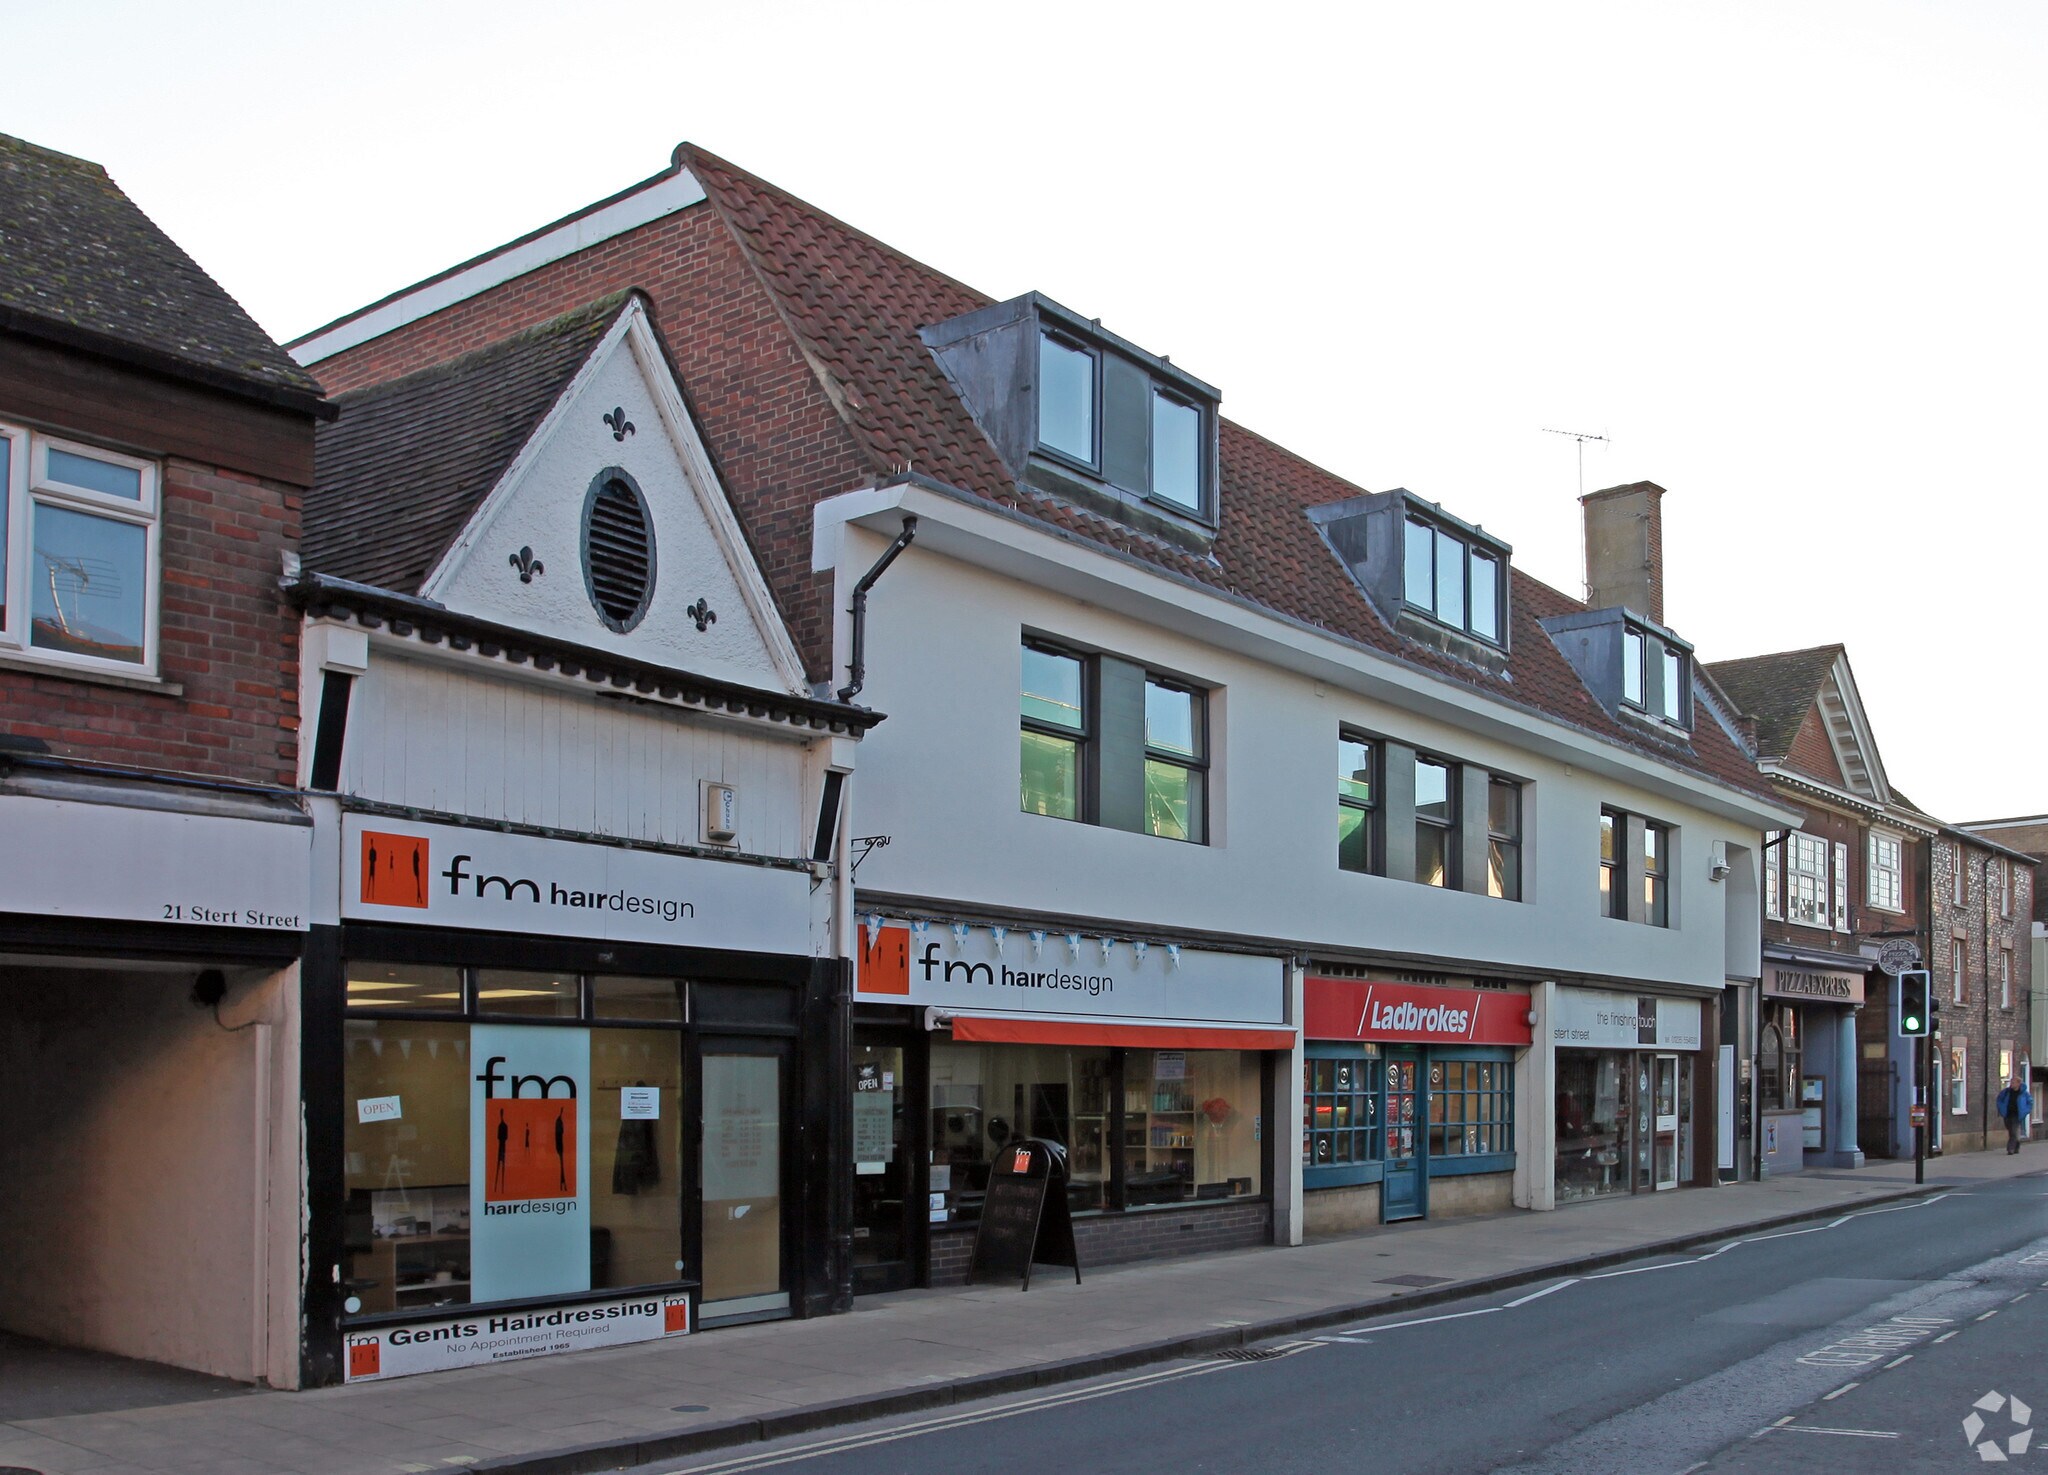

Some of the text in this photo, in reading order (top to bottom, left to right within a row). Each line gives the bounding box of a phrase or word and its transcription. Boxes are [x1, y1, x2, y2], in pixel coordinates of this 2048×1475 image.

[442, 854, 540, 904] fm
[163, 904, 300, 928] 21 Stert Street
[917, 942, 994, 985] fm
[1775, 970, 1851, 998] PIZZAEXPRESS
[1370, 1000, 1469, 1033] Ladbrokes
[1596, 1012, 1656, 1030] the finishing touch
[1554, 1029, 1590, 1041] stert street
[476, 1056, 577, 1099] fm
[858, 1078, 878, 1091] OPEN
[363, 1102, 394, 1115] OPEN
[1015, 1147, 1031, 1156] fm
[662, 1295, 686, 1306] fm
[388, 1299, 659, 1347] Gents Hairdressing
[346, 1333, 381, 1346] fm
[447, 1323, 610, 1354] No Appointment Required
[492, 1342, 571, 1359] Established 1965
